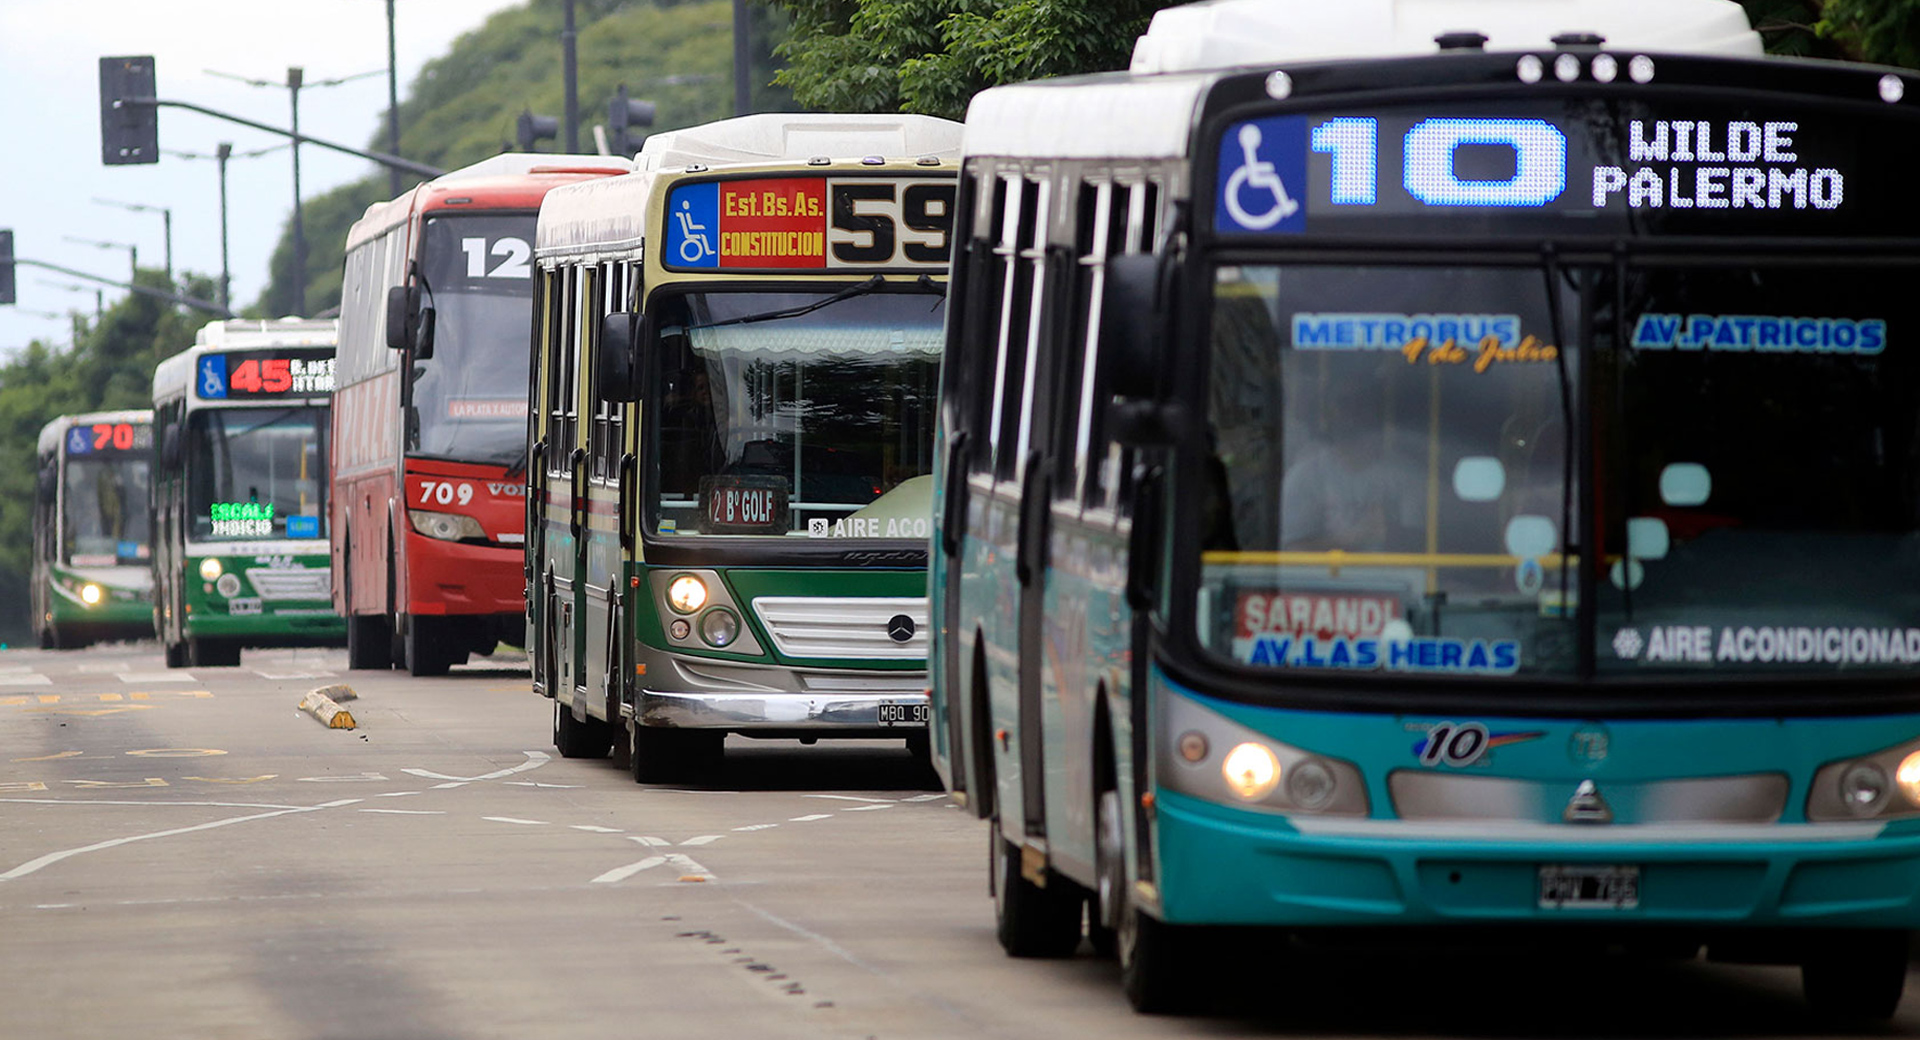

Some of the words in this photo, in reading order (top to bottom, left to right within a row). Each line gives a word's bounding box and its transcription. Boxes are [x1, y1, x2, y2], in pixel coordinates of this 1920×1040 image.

[1629, 120, 1798, 162] WILDE
[1311, 117, 1568, 206] 10
[1592, 166, 1844, 209] PALERMO
[725, 192, 824, 217] Est.Bs.As.
[830, 182, 957, 263] 59
[462, 237, 532, 278] 12
[721, 231, 823, 257] CONSTITUCION
[1296, 316, 1516, 347] METROBUS
[1473, 334, 1558, 373] Julio
[230, 359, 292, 392] 45
[453, 404, 465, 417] LA
[466, 404, 490, 416] PLATA
[92, 423, 133, 450] 70
[420, 482, 473, 505] 709
[742, 490, 773, 522] GOLF
[833, 518, 880, 538] AIRE
[886, 518, 932, 538] ACO
[1388, 638, 1518, 671] HERAS
[1647, 626, 1712, 661] AIRE
[1717, 626, 1920, 664] ACONDICIONAD
[880, 706, 905, 721] MBQ
[1423, 723, 1487, 765] 10
